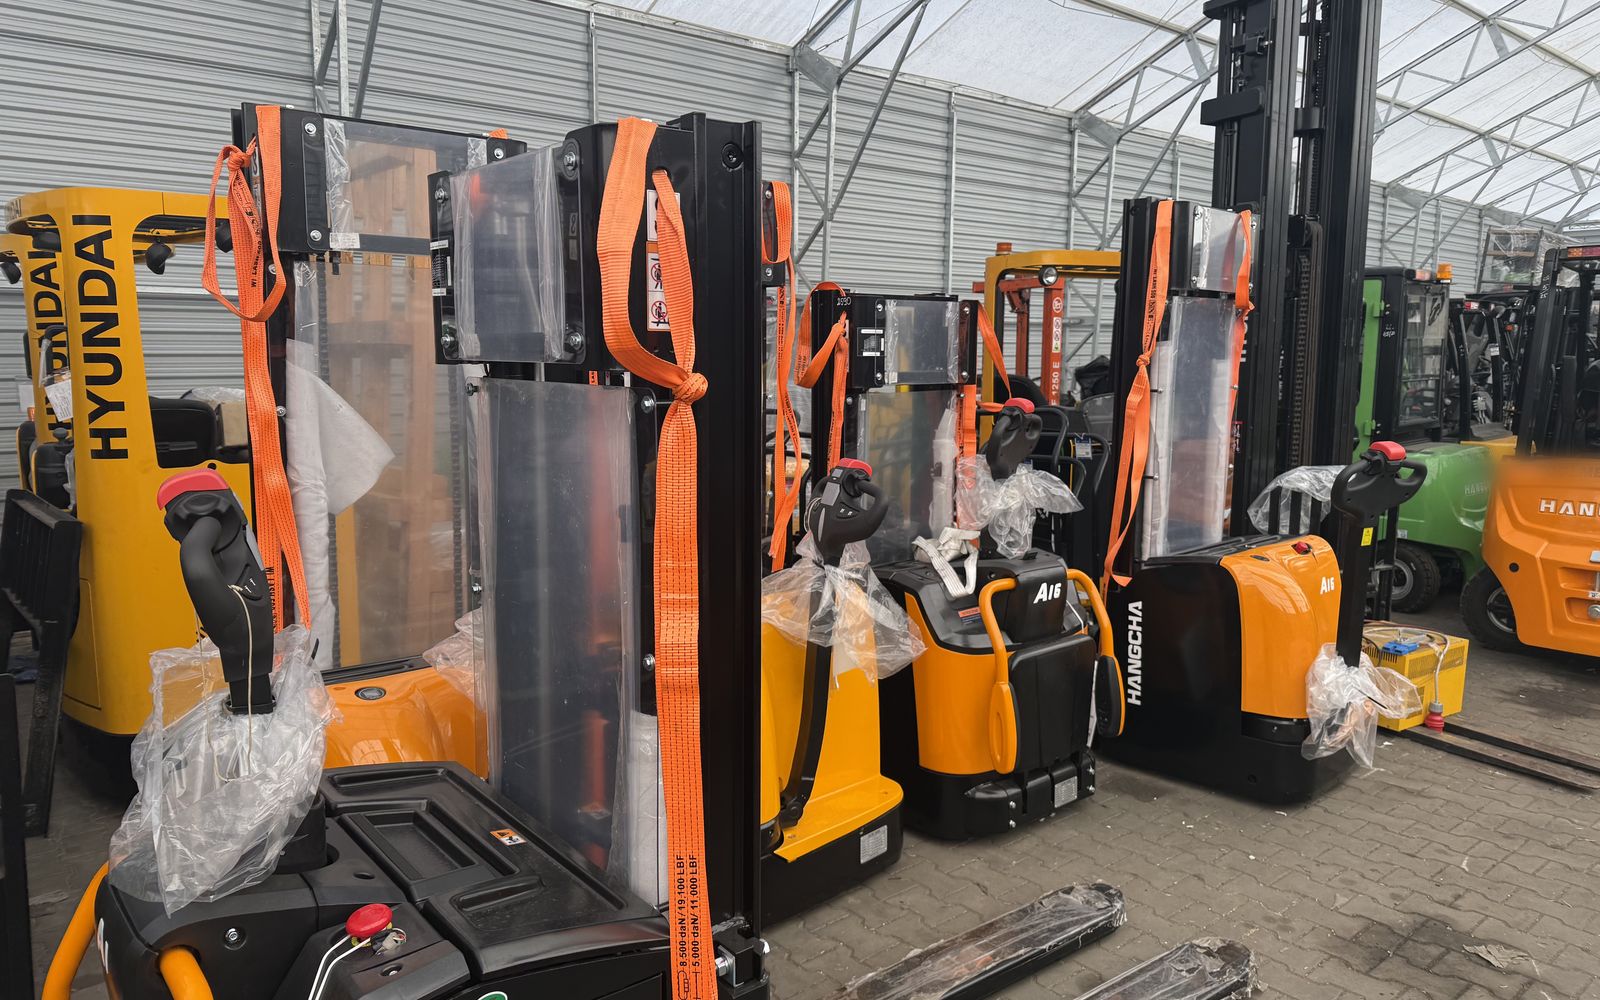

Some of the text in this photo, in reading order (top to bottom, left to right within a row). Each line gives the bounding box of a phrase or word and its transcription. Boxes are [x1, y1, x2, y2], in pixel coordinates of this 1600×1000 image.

[72, 214, 129, 460] HYUNDAI
[1053, 361, 1060, 369] E
[1051, 371, 1059, 396] 1250
[1539, 498, 1600, 517] HAN
[1033, 582, 1062, 604] A16
[1319, 576, 1335, 595] A16
[1127, 600, 1143, 706] HANGCHA
[676, 854, 685, 876] LBF
[689, 854, 697, 875] LBF
[678, 940, 687, 967] 8.500
[691, 940, 700, 967] 5.000
